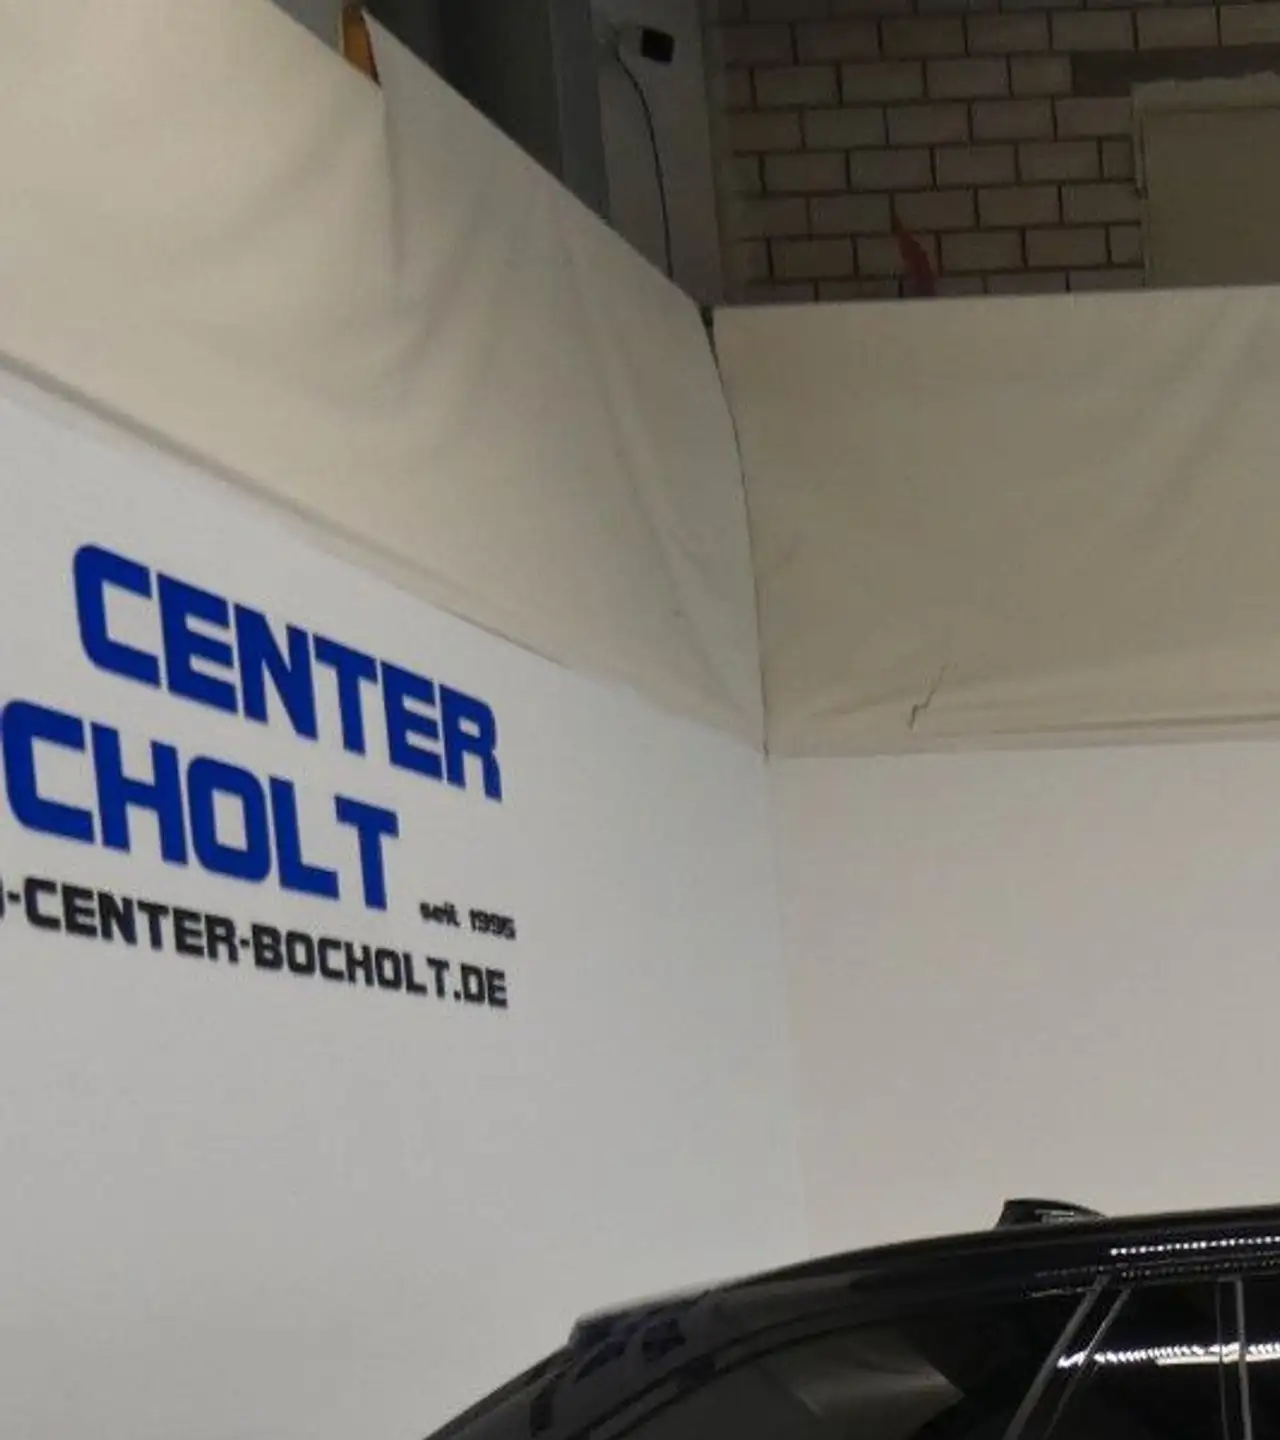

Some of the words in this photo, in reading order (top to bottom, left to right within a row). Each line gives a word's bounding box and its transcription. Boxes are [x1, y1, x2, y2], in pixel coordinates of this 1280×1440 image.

[72, 543, 503, 803] CENTER
[0, 699, 400, 911] CHOLT
[0, 876, 508, 1009] -CENTER-BOCHOLT.DE
